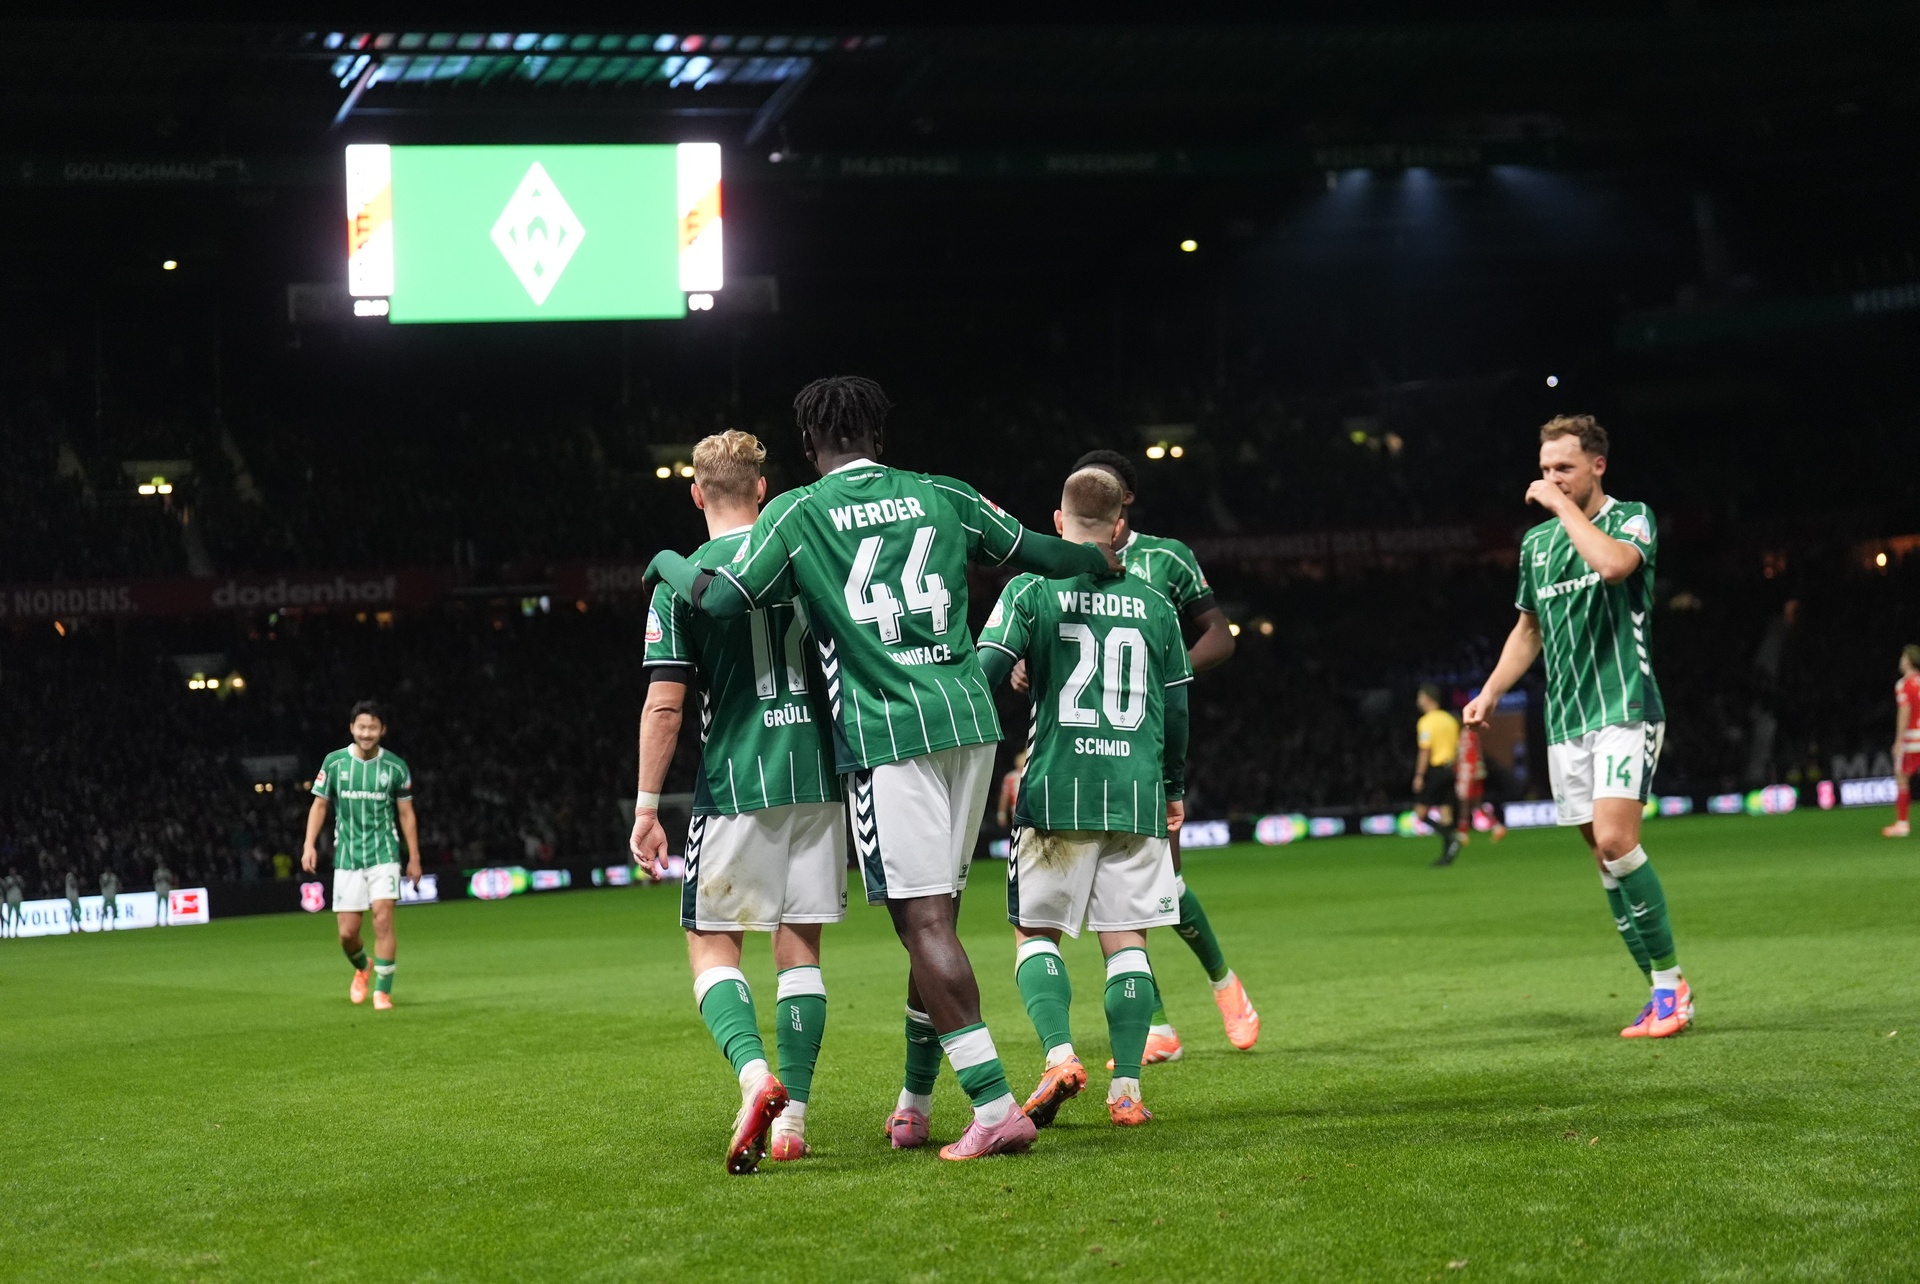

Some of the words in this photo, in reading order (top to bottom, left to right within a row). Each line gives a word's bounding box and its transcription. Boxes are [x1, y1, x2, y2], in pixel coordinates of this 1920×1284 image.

[829, 497, 926, 532] WERDER
[14, 586, 139, 617] NORDENS.
[844, 526, 951, 646] 44
[1057, 591, 1147, 619] WERDER
[1058, 622, 1148, 731] 20
[763, 702, 811, 727] GRÜLL
[1074, 737, 1131, 757] SCHMID
[1606, 755, 1631, 787] 14
[388, 874, 397, 893] 3
